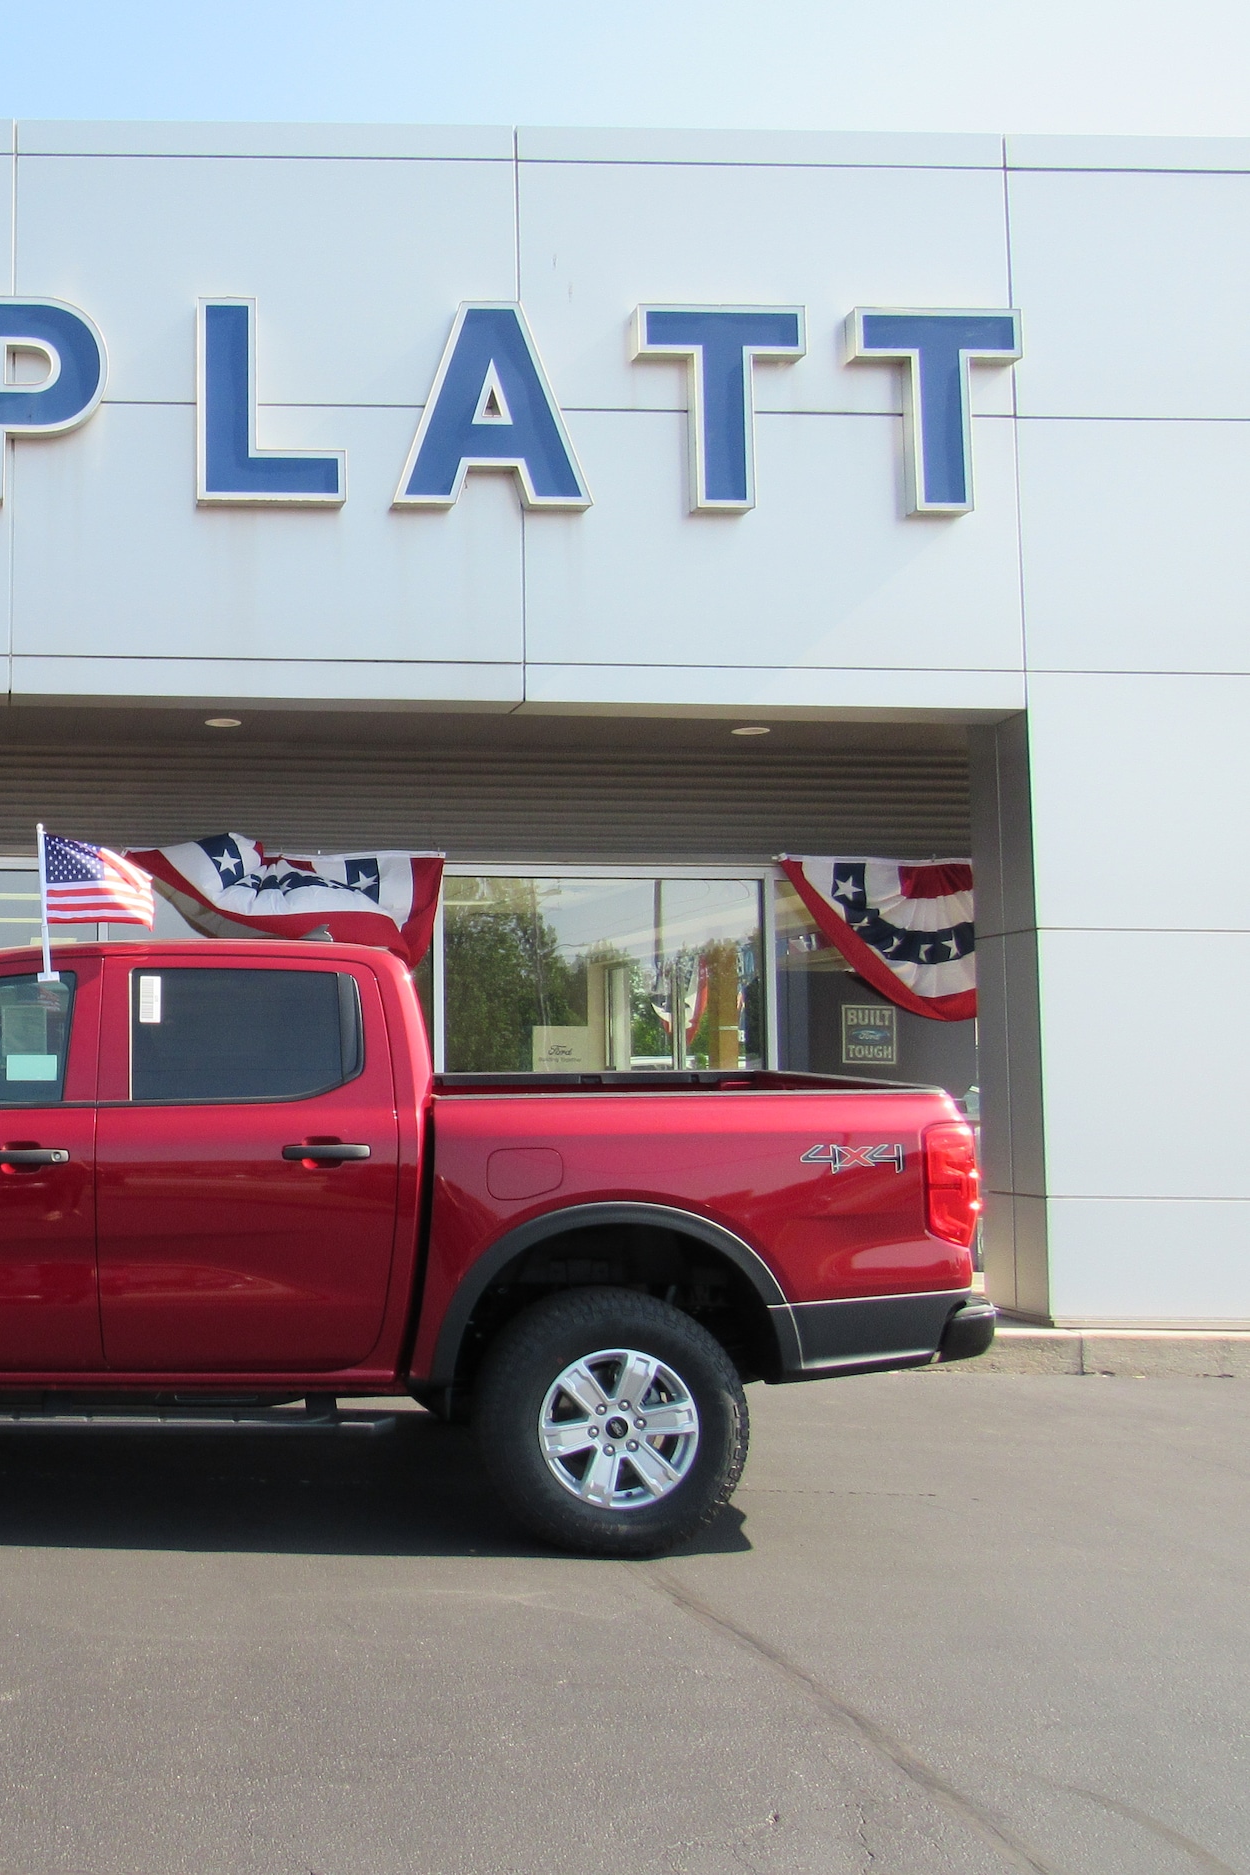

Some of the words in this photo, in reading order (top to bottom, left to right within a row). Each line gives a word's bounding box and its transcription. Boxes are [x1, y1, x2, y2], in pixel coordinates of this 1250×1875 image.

[846, 1009, 891, 1026] BUILT
[547, 1044, 573, 1056] Ford
[847, 1045, 892, 1058] TOUGH
